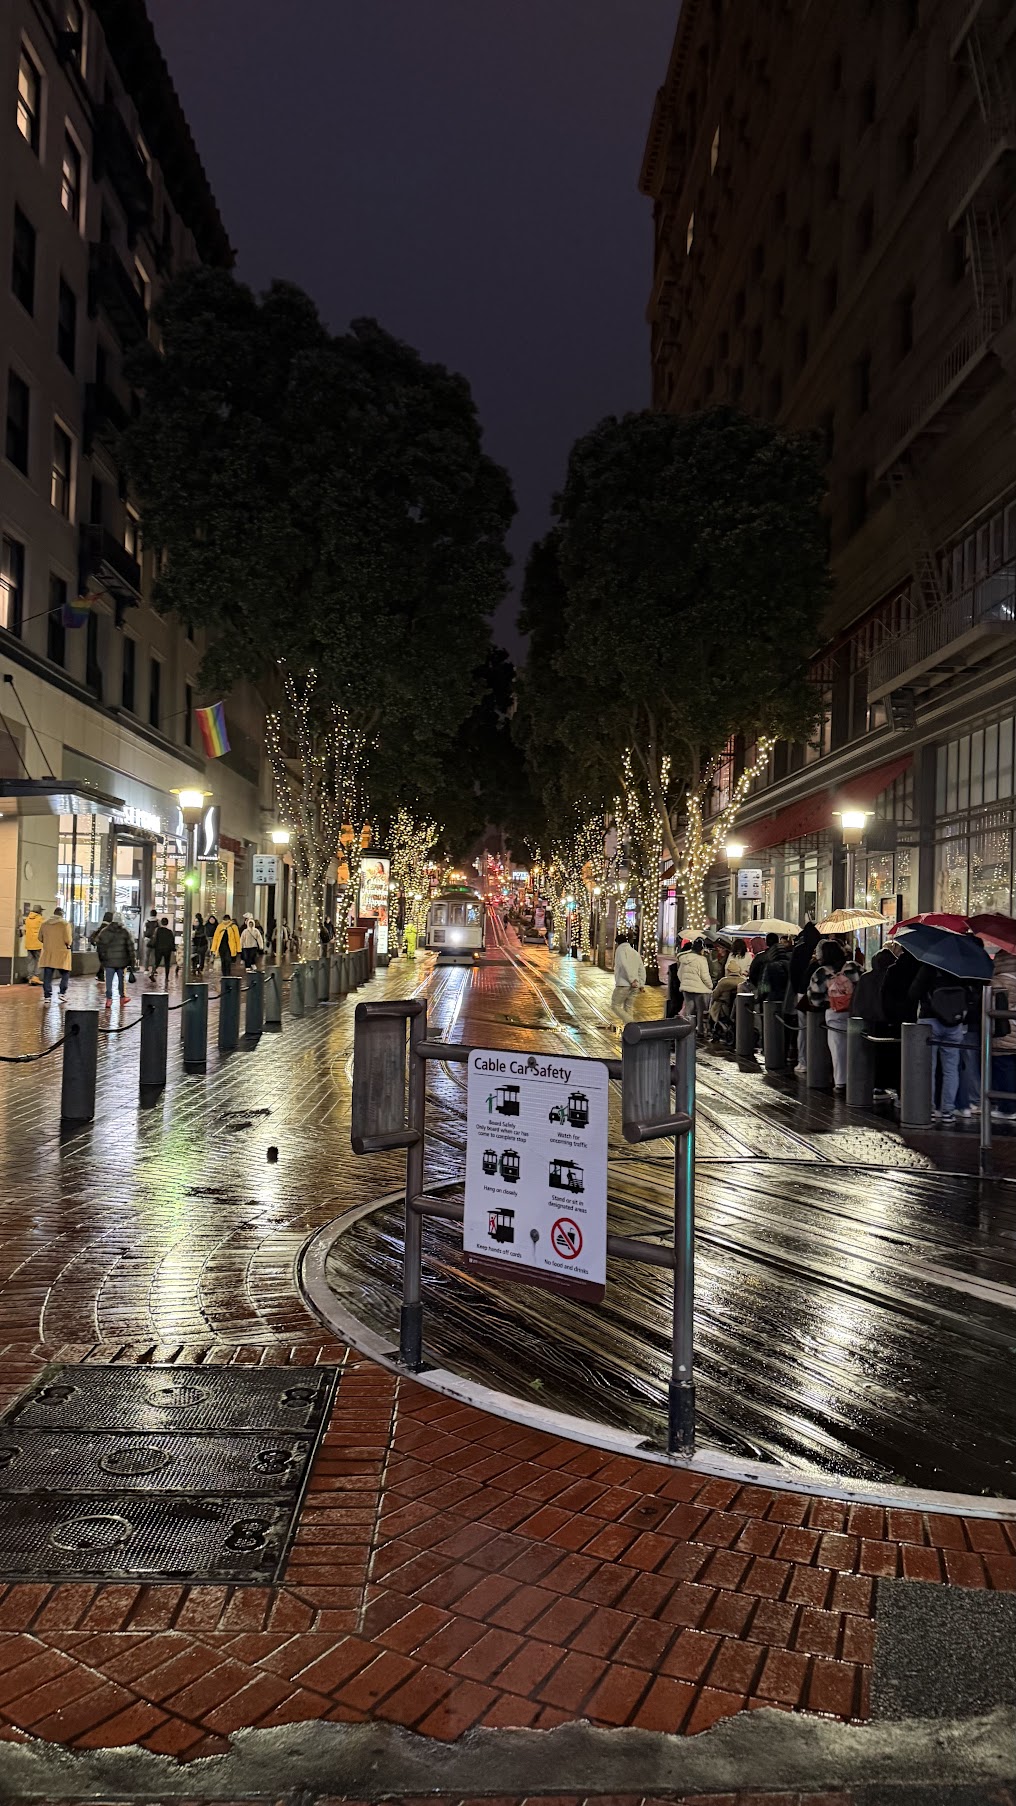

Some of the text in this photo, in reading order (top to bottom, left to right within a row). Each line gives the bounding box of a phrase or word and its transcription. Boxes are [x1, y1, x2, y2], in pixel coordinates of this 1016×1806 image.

[474, 1057, 571, 1083] Cable Car Safety
[476, 1123, 486, 1131] Only
[550, 1138, 588, 1149] oncoming traffic
[484, 1184, 495, 1194] Hang
[503, 1188, 518, 1197] closely
[548, 1200, 573, 1211] designated
[477, 1243, 487, 1251] Keep
[489, 1246, 502, 1254] hands
[552, 1261, 563, 1269] food
[574, 1266, 589, 1275] drinks
